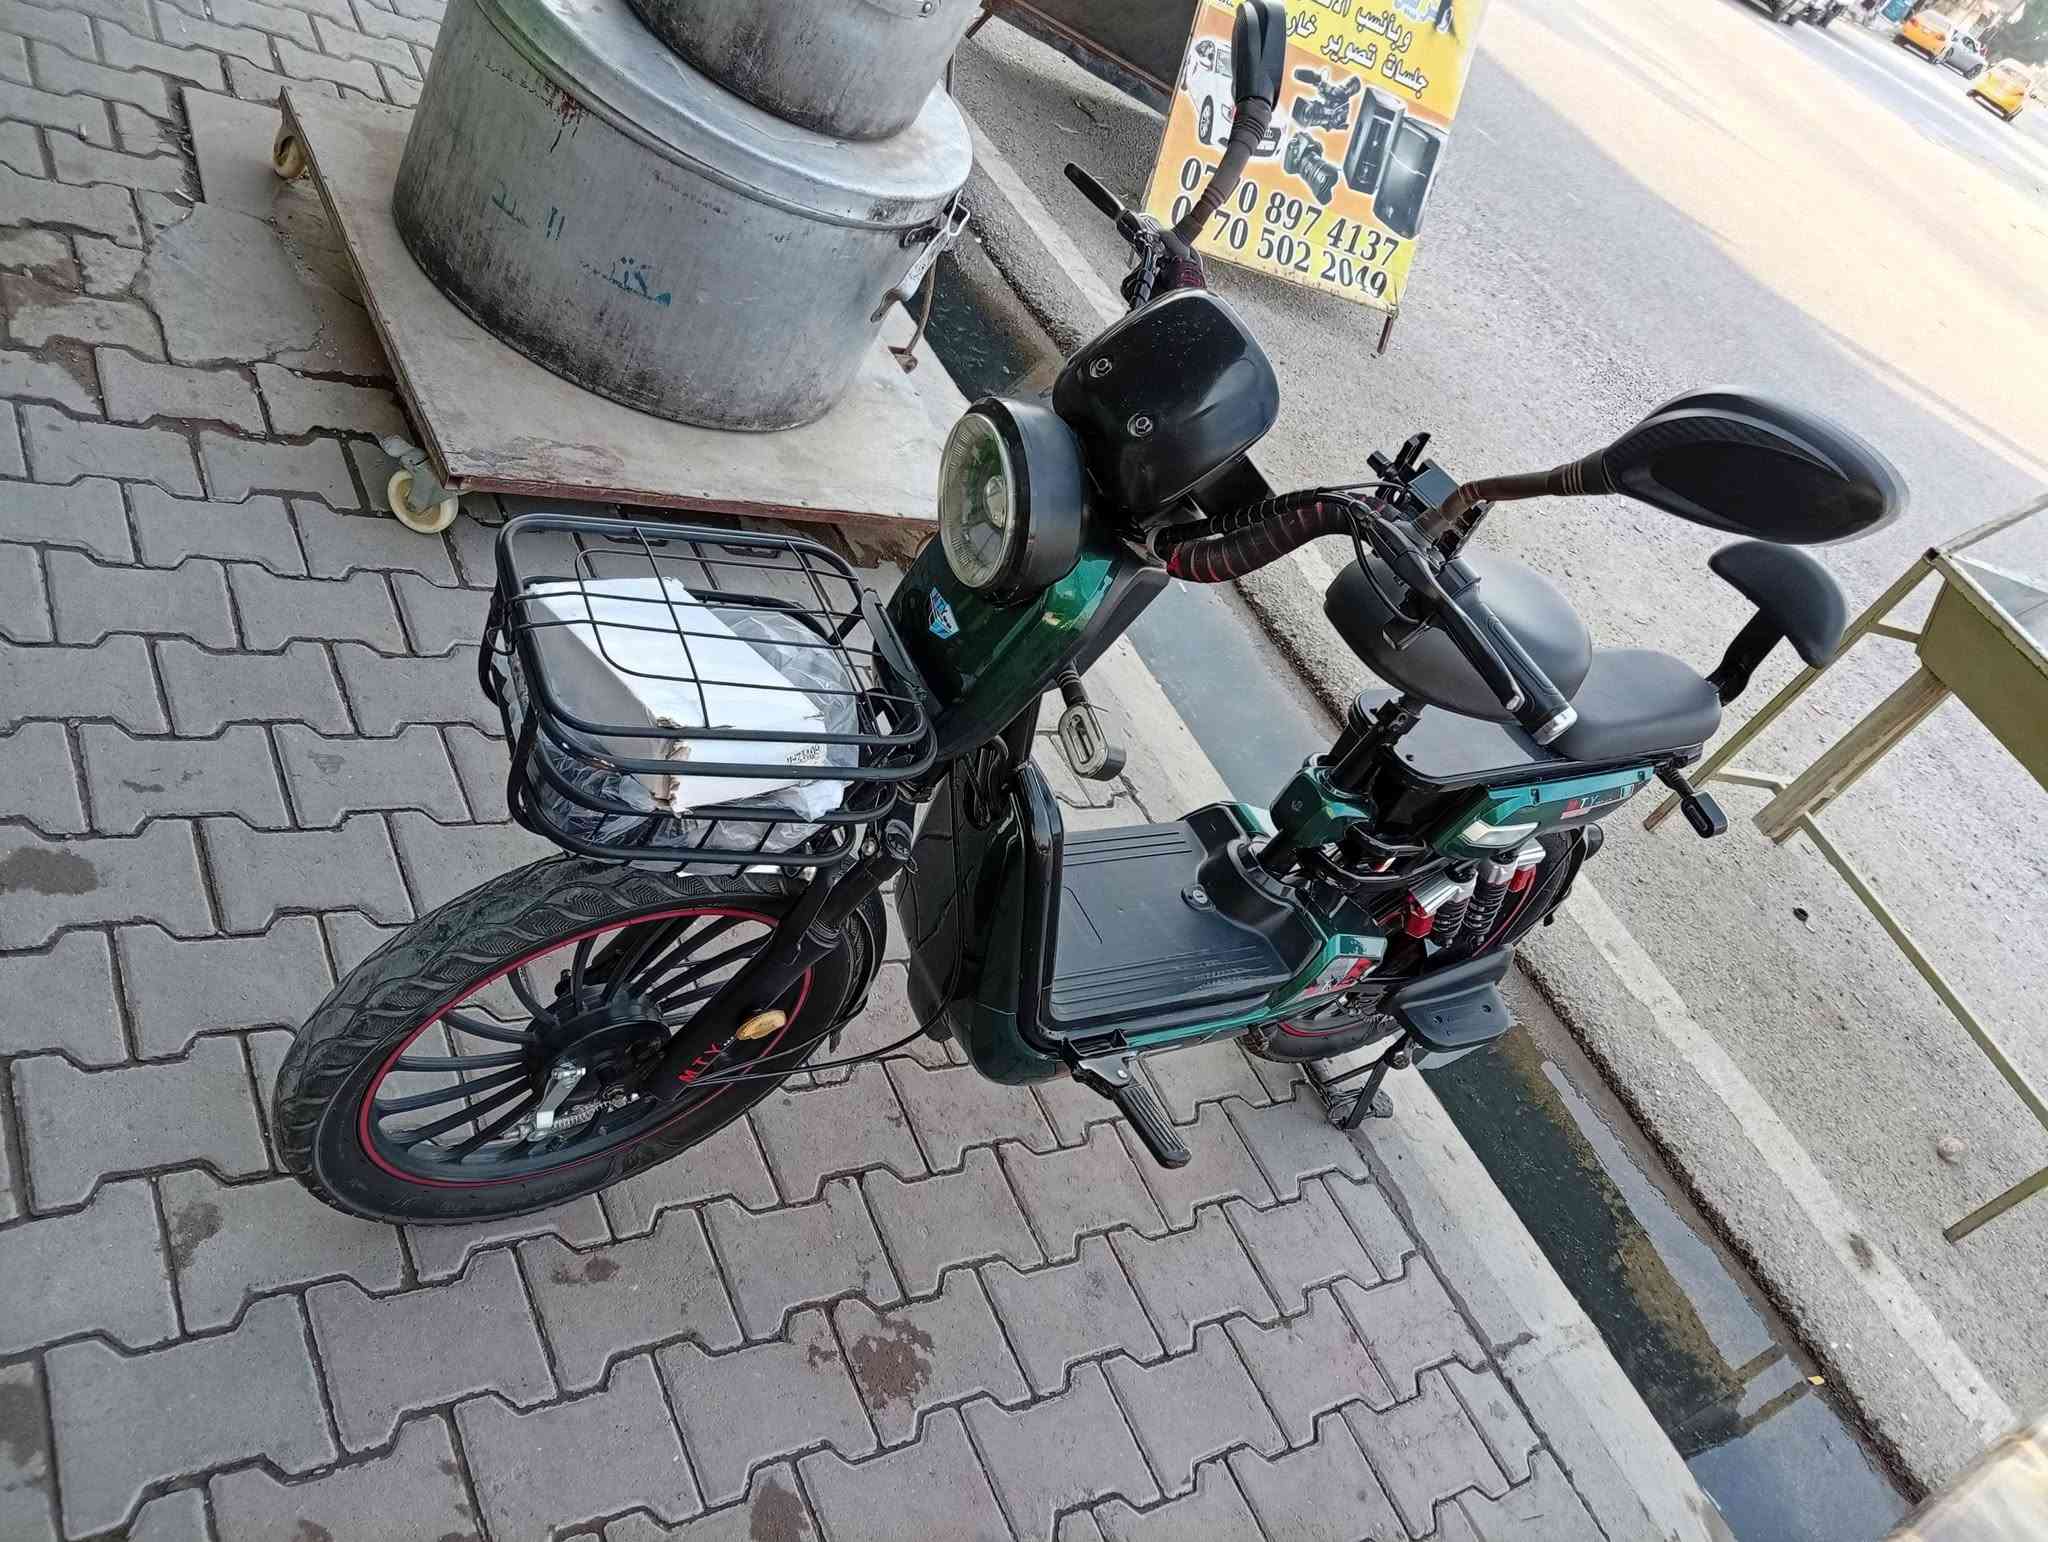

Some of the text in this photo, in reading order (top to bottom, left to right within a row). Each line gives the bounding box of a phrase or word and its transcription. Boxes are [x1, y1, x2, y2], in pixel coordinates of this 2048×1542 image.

[1286, 12, 1428, 99] جلسات تصوير خار
[1171, 195, 1387, 298] 070 502 2049
[1265, 192, 1322, 236] 897
[1327, 217, 1399, 266] 4137
[678, 1043, 720, 1082] MTY
